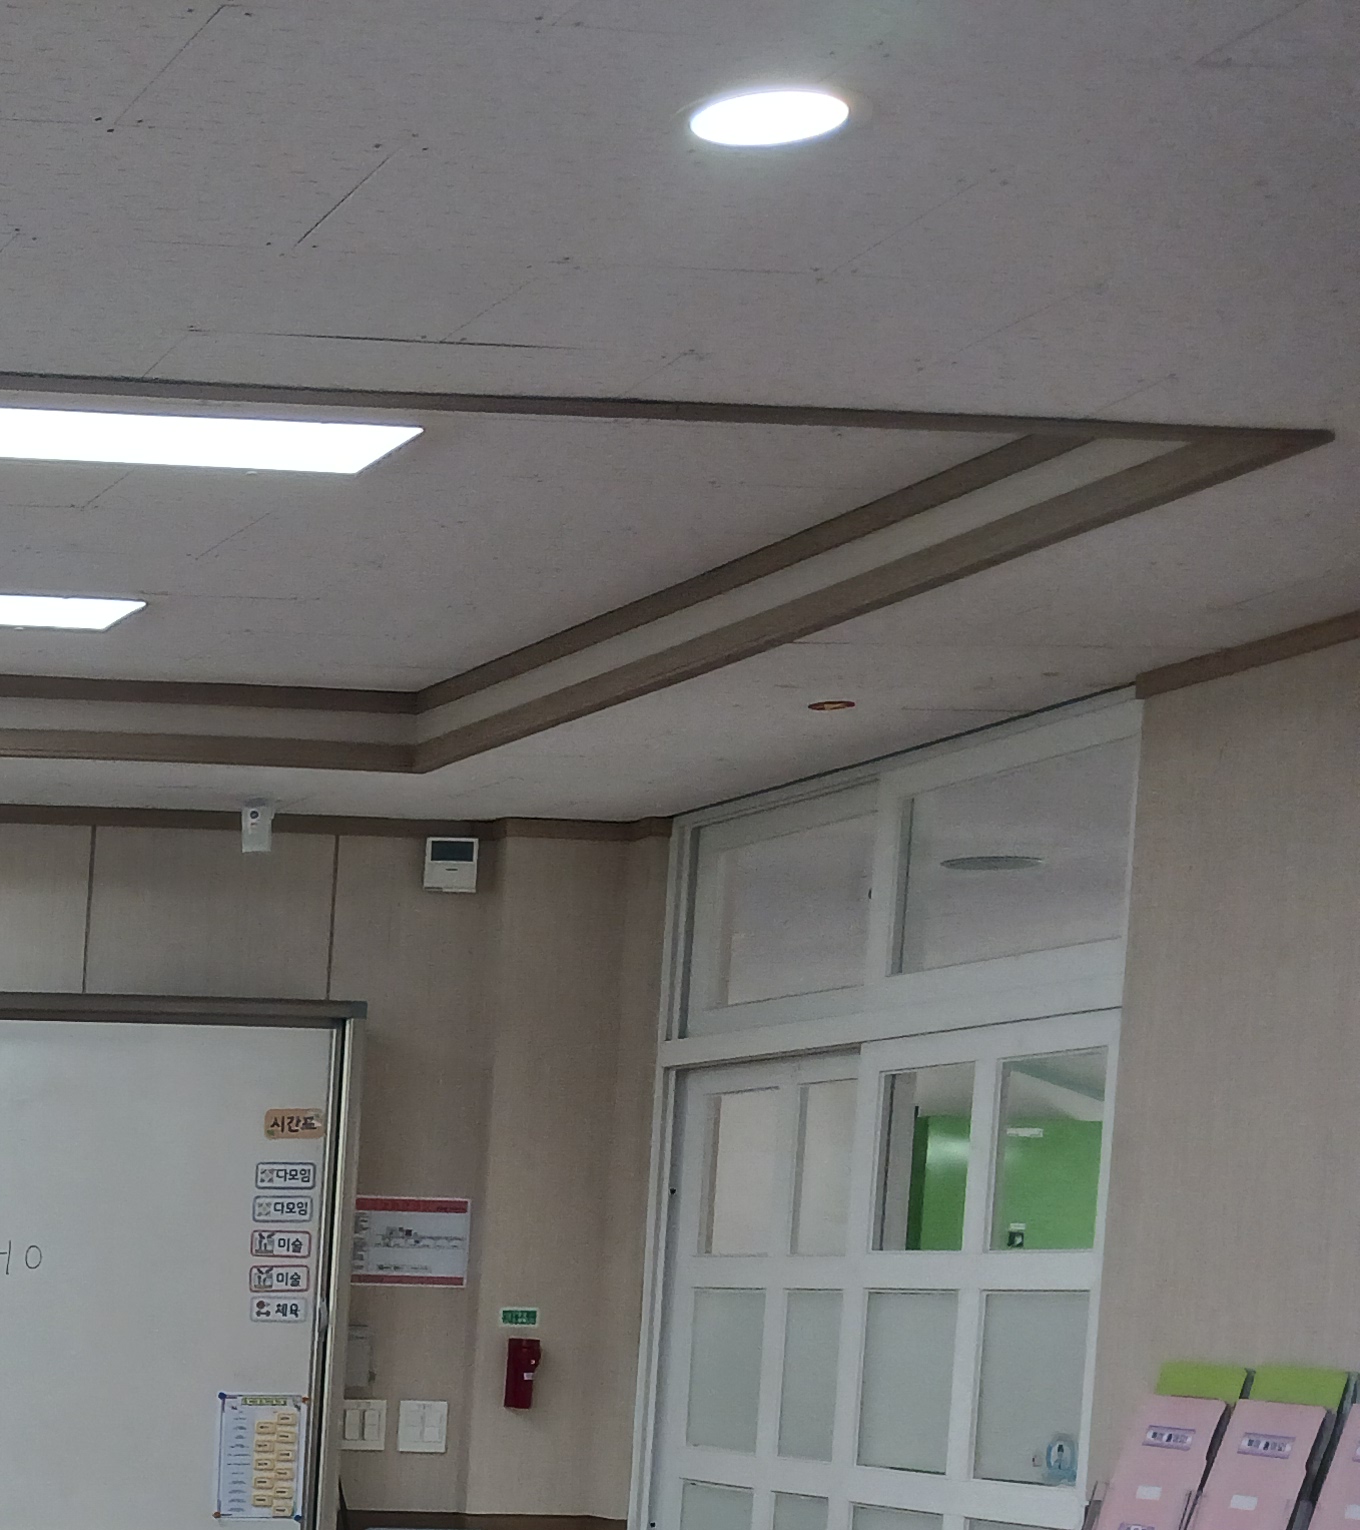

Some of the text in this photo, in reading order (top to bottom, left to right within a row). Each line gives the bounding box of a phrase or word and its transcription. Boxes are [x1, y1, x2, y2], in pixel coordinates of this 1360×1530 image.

[270, 1115, 317, 1133] 시간표
[276, 1168, 311, 1183] 다모임
[273, 1201, 308, 1216] 다모임
[277, 1238, 303, 1253] 미술
[276, 1272, 301, 1287] 미술
[275, 1303, 300, 1318] 체육
